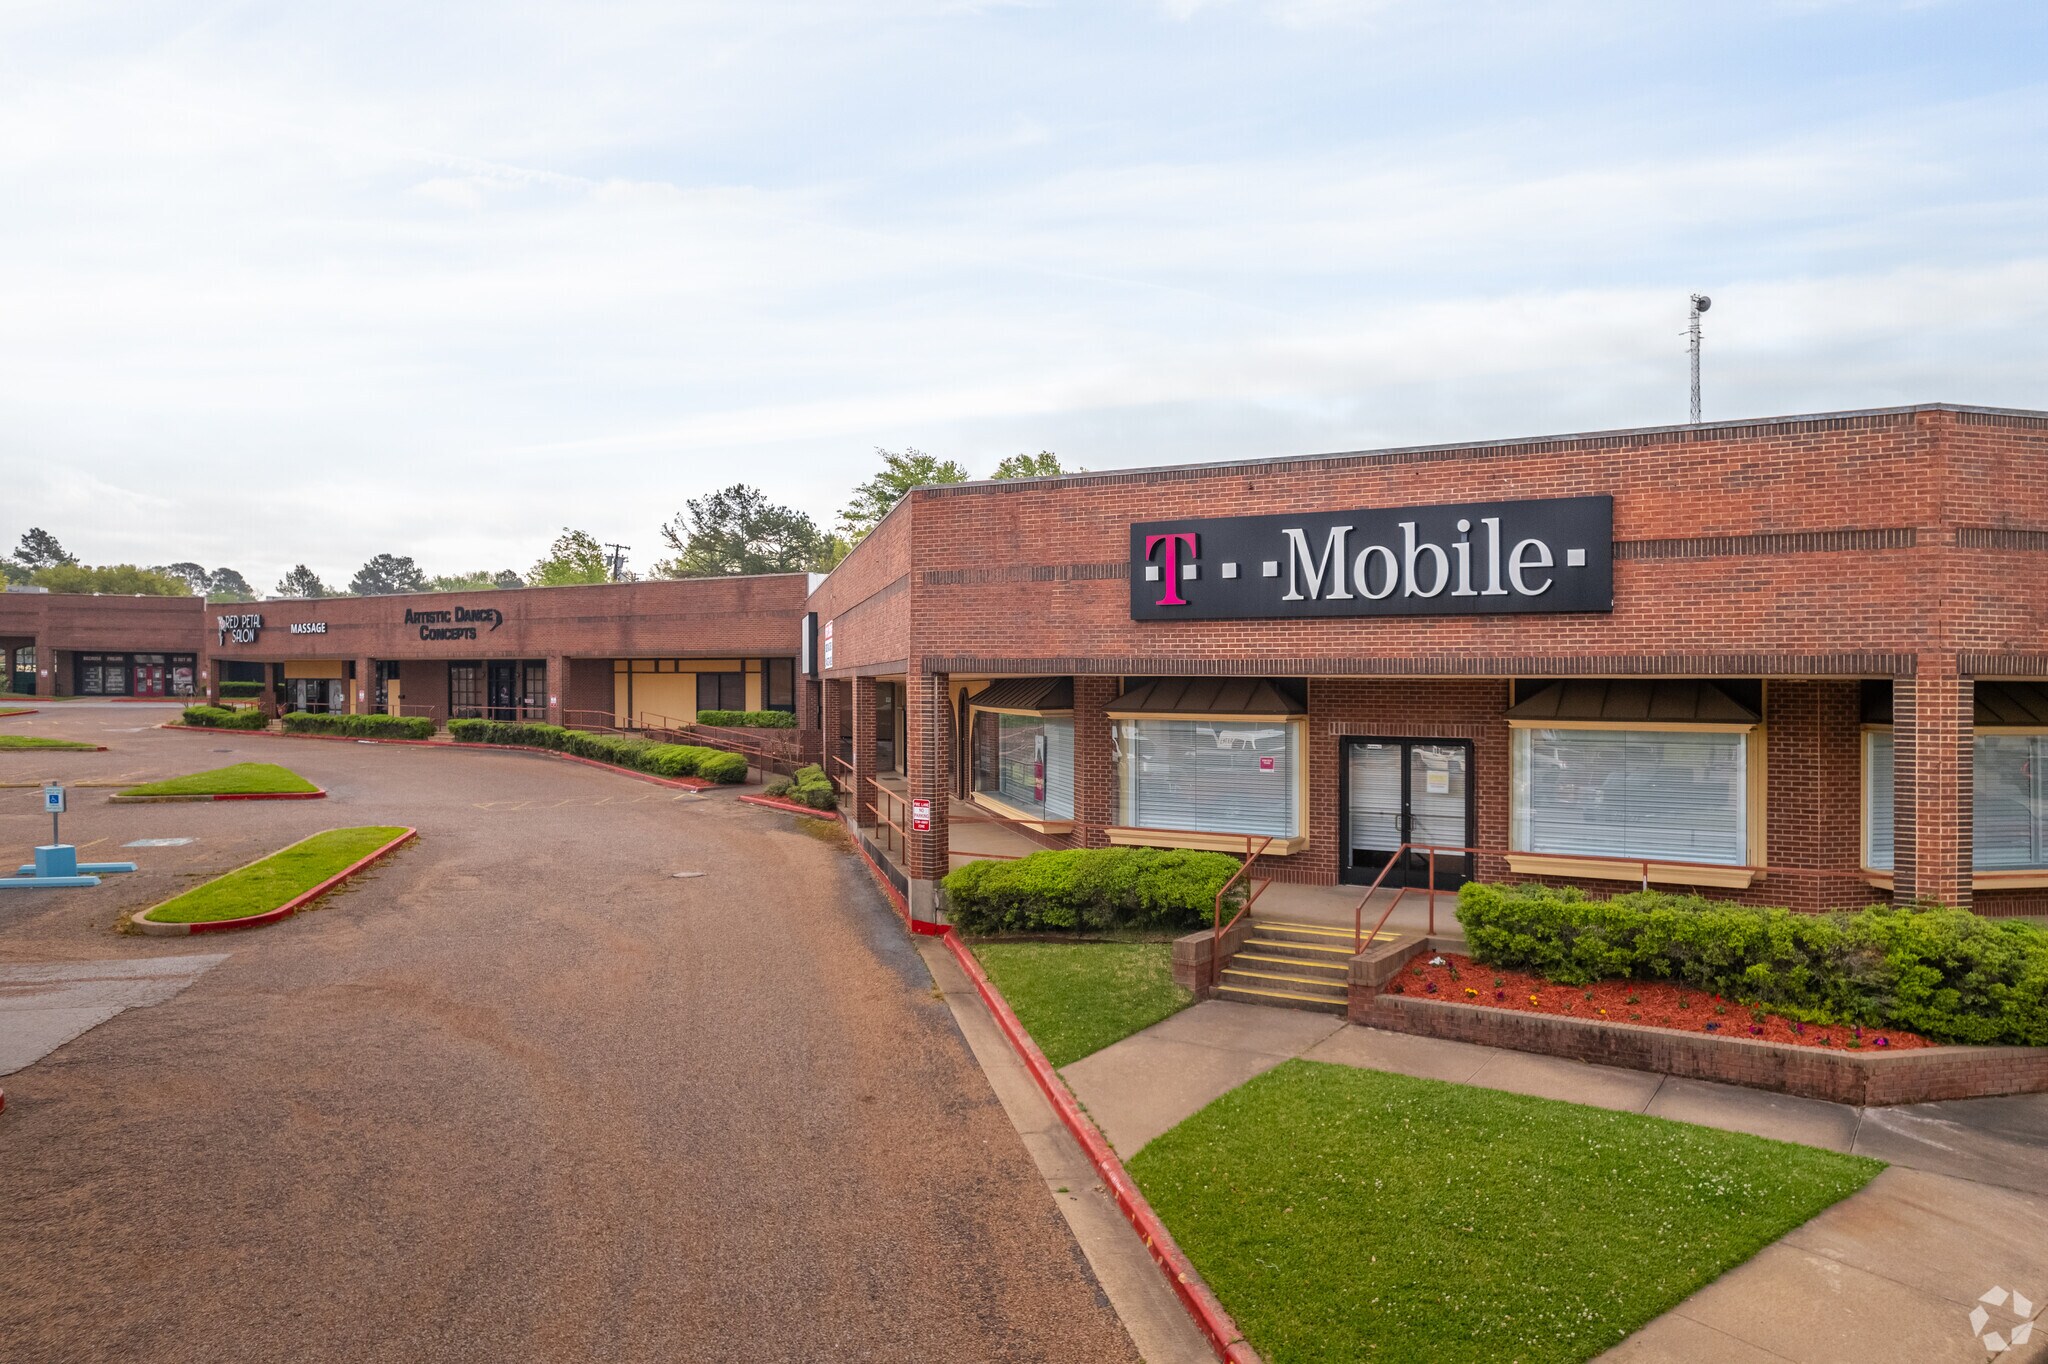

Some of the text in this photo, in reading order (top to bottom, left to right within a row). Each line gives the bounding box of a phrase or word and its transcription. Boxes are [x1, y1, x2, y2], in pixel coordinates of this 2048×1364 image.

[1282, 517, 1555, 600] Mobile
[225, 614, 261, 629] RED PETAL
[290, 622, 326, 634] MASSAGE
[231, 629, 255, 643] SALON
